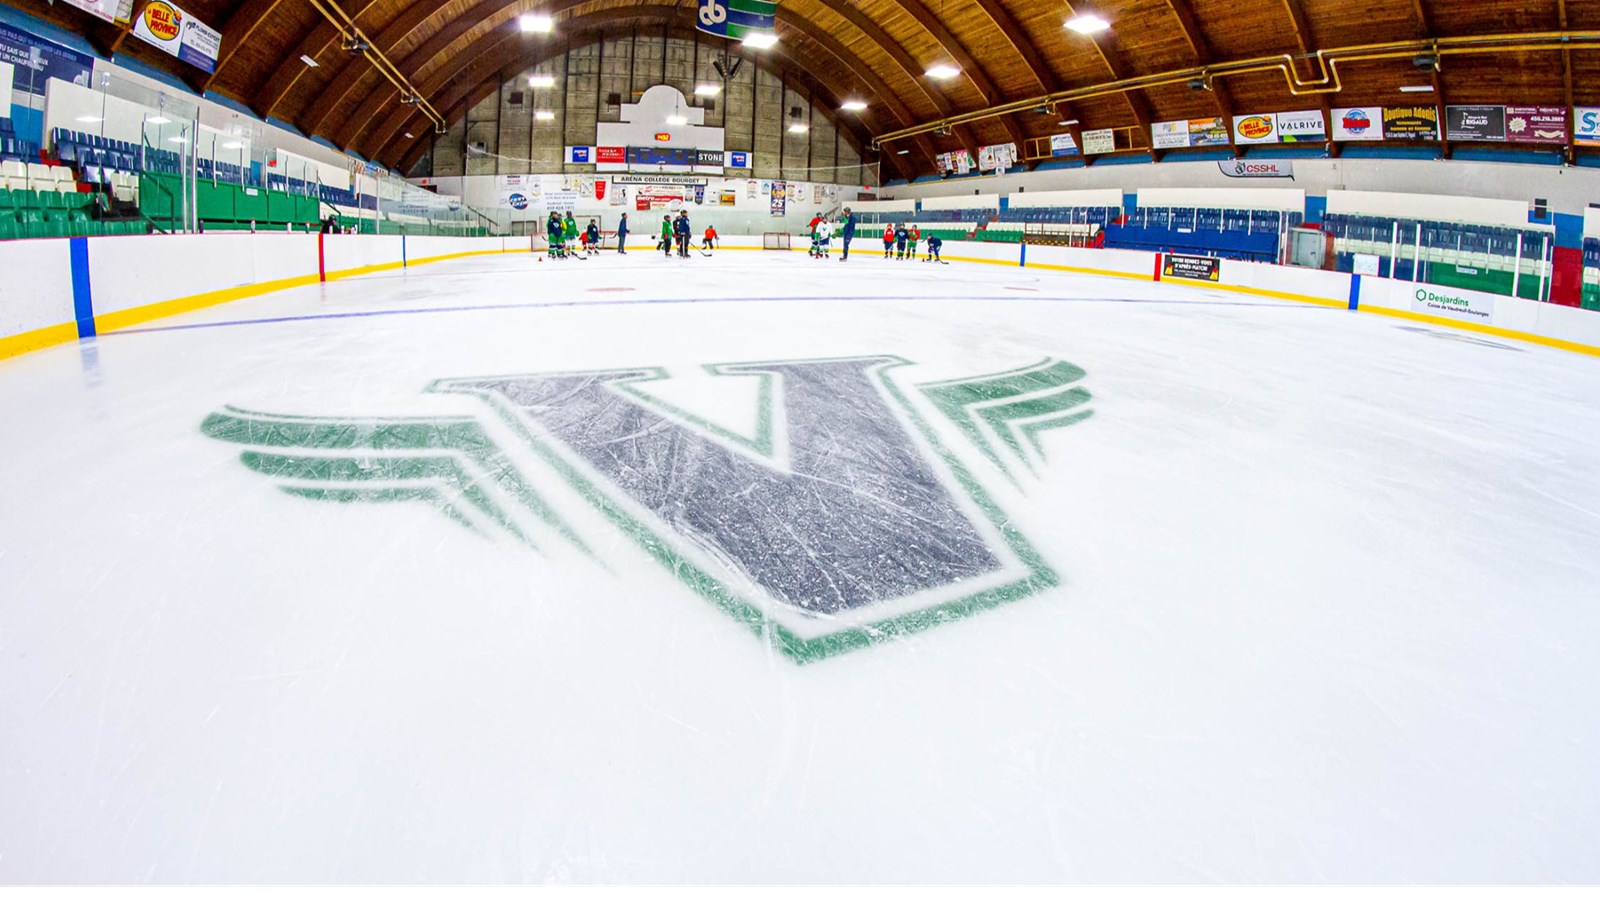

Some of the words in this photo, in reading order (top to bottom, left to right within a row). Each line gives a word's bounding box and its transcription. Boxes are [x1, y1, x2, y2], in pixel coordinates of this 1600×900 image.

[151, 9, 170, 23] BELLE
[150, 20, 178, 36] PROVINCE
[1383, 107, 1412, 122] Boutique
[1243, 121, 1260, 130] BELLE
[1280, 121, 1322, 130] VALRIVE
[1245, 126, 1270, 137] PROVINCE
[698, 153, 723, 162] STONE
[1246, 164, 1280, 173] CSSHL
[772, 199, 784, 208] 25
[1428, 292, 1469, 307] Desjardins
